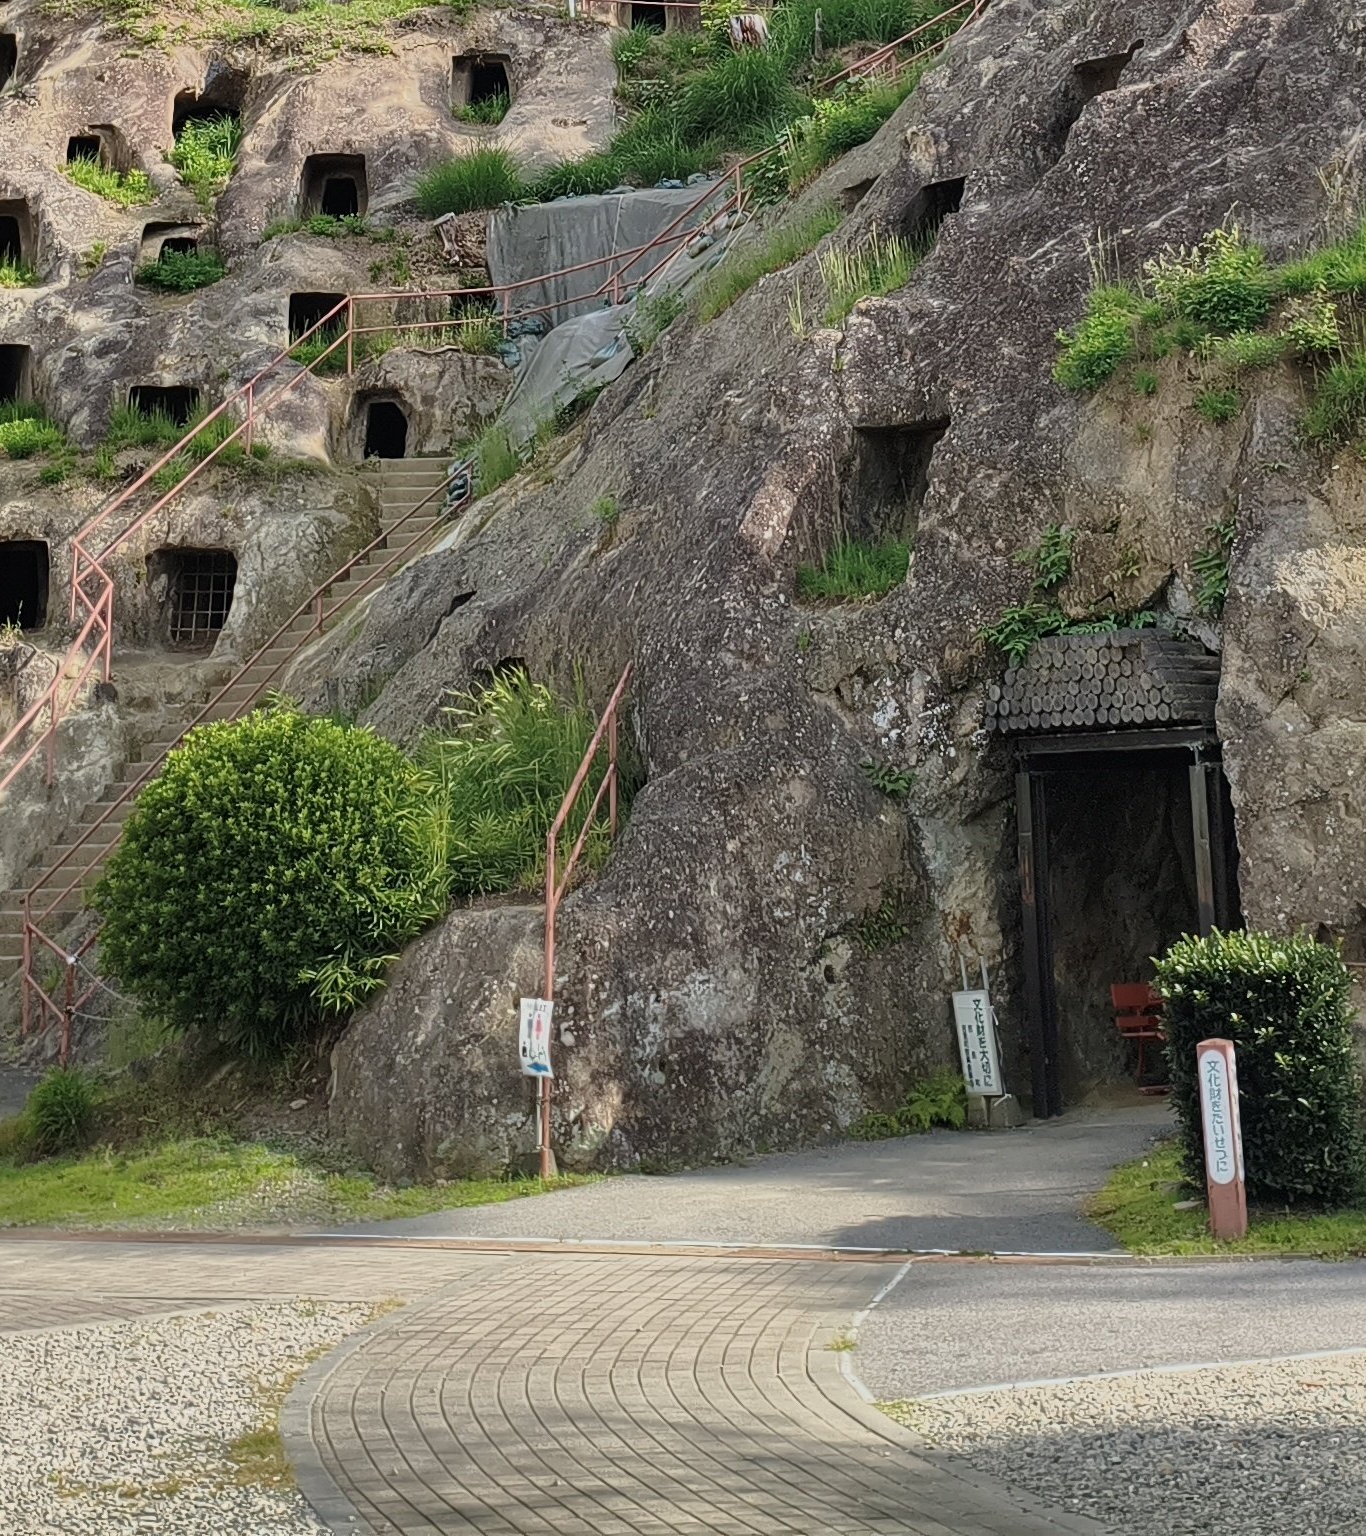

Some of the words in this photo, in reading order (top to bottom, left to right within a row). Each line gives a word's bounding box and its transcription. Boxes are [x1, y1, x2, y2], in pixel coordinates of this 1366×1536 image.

[972, 999, 993, 1087] 文化財を大切に
[1206, 1060, 1229, 1172] 文化財をたいせつに
